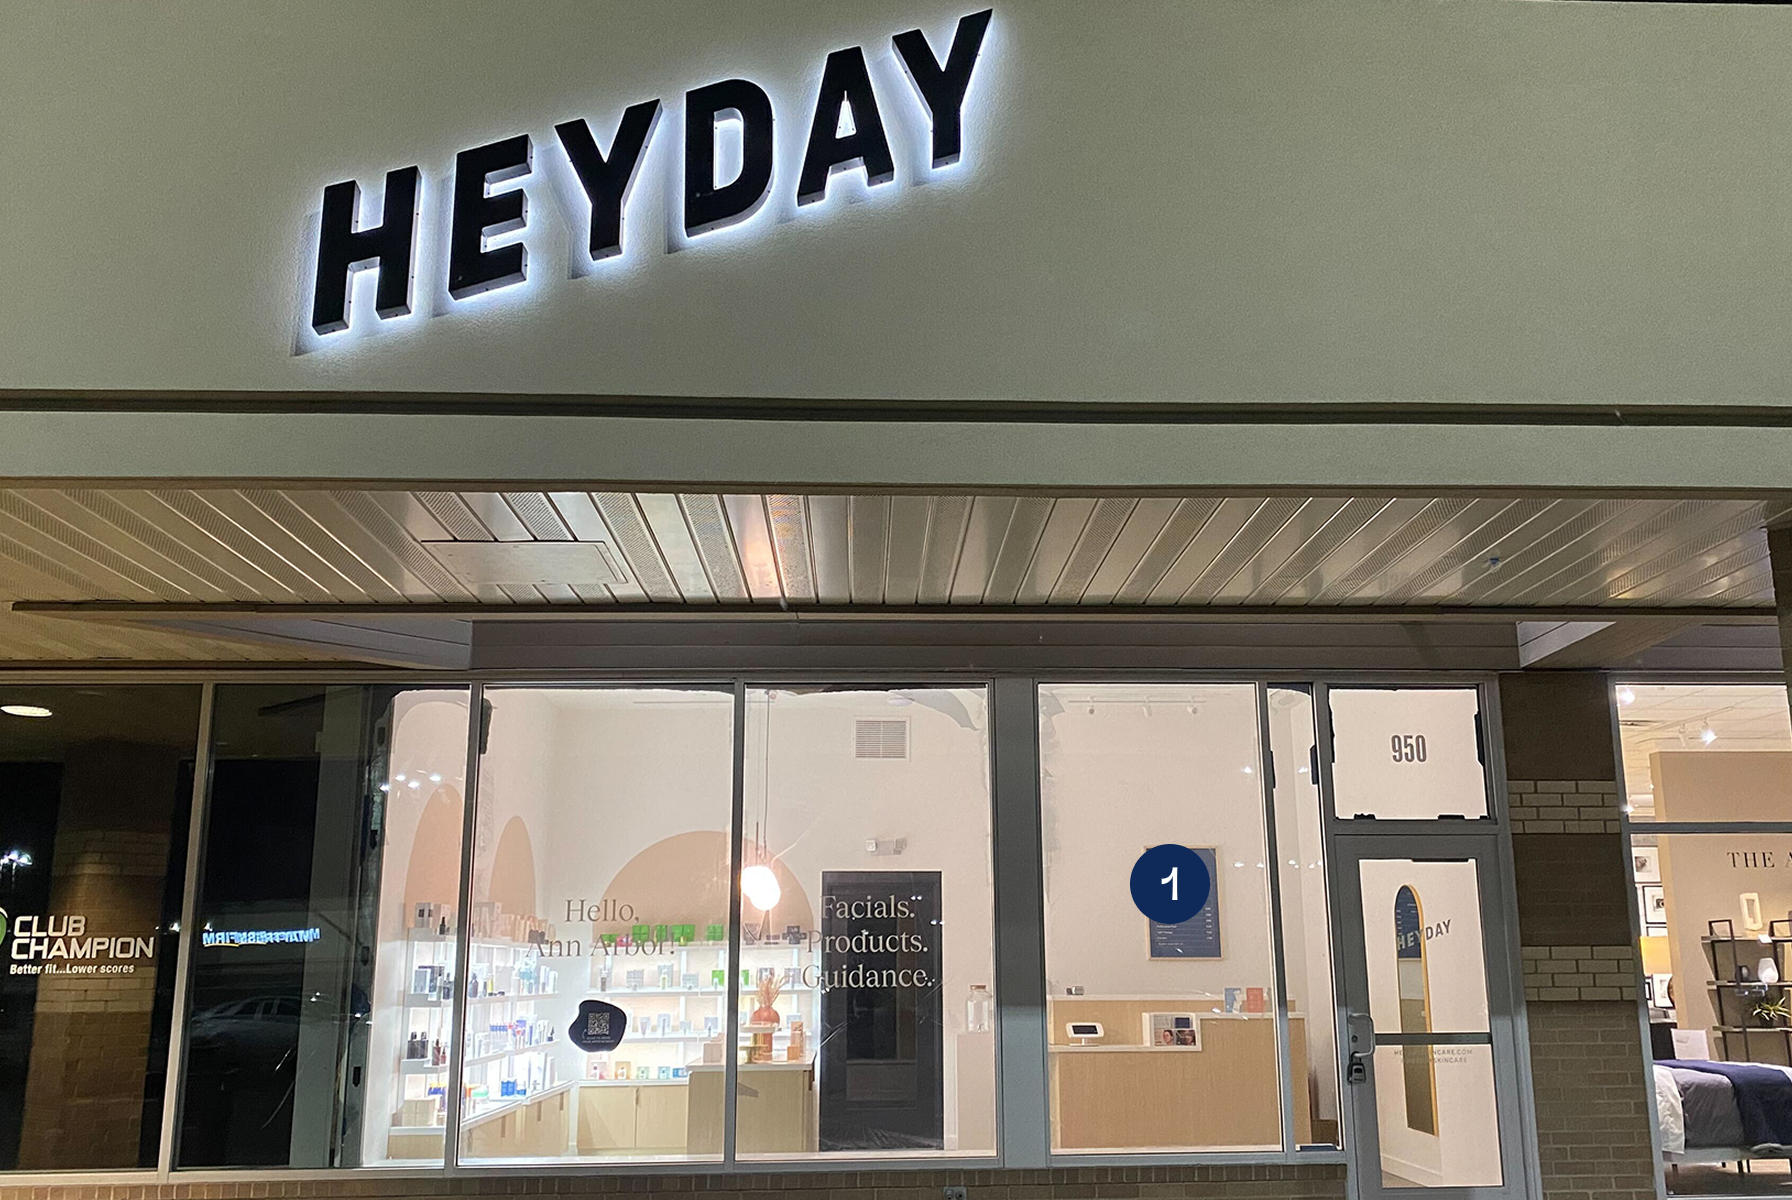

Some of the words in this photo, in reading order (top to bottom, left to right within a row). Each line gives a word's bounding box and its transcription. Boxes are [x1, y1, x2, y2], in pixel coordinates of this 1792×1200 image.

[312, 8, 993, 336] HEYDAY
[1391, 734, 1427, 763] 950
[1726, 851, 1775, 868] THE
[565, 899, 640, 923] Hello,
[820, 895, 915, 919] Facials.
[13, 915, 86, 937] CLUB
[1397, 918, 1451, 951] HEYDAY
[11, 937, 155, 960] CHAMPION
[525, 932, 581, 957] Ann
[590, 933, 675, 957] Arbor!
[806, 930, 929, 953] Products.
[10, 963, 42, 975] Better
[100, 964, 135, 974] scores
[802, 964, 933, 988] Guidance.
